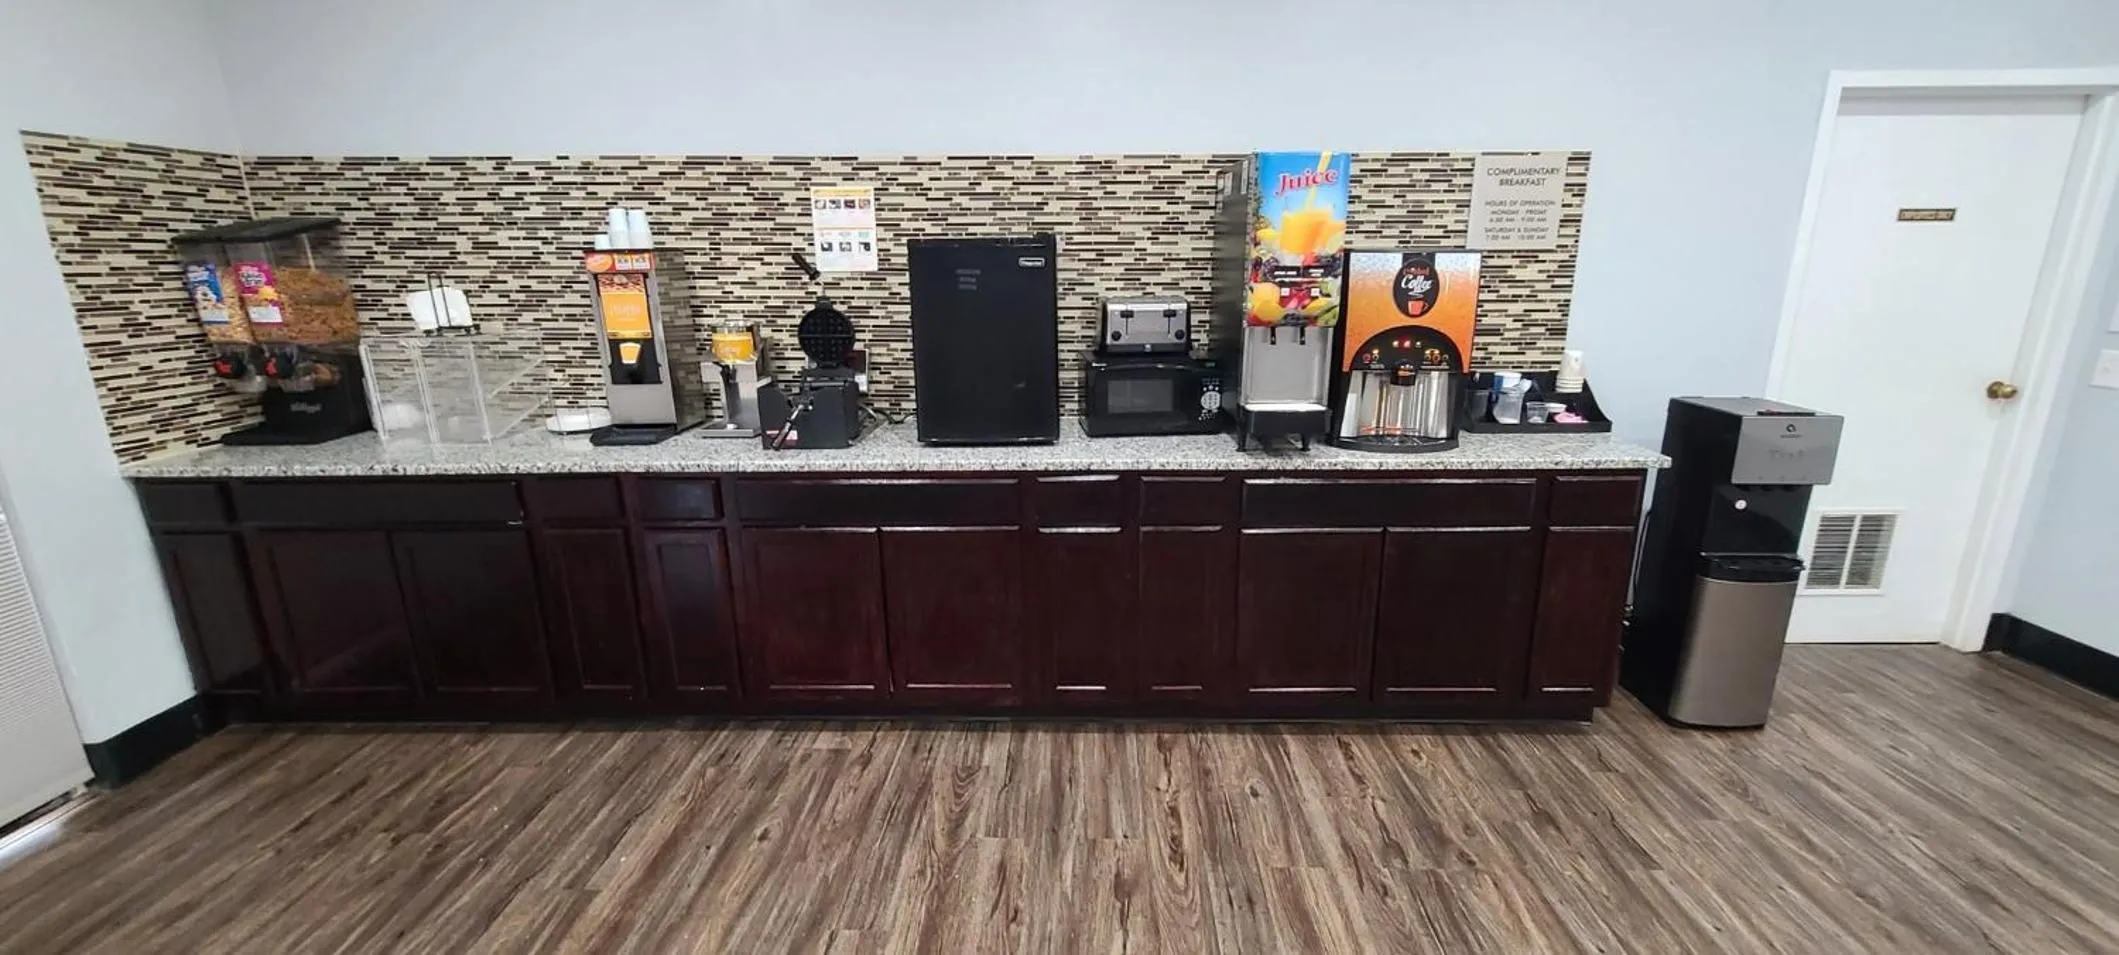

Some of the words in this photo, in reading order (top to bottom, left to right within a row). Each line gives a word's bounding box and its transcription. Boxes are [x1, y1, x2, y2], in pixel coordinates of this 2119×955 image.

[1487, 168, 1560, 176] COMPLIMENTARY
[1275, 168, 1339, 196] Juice
[1499, 178, 1546, 186] BREAKFAST
